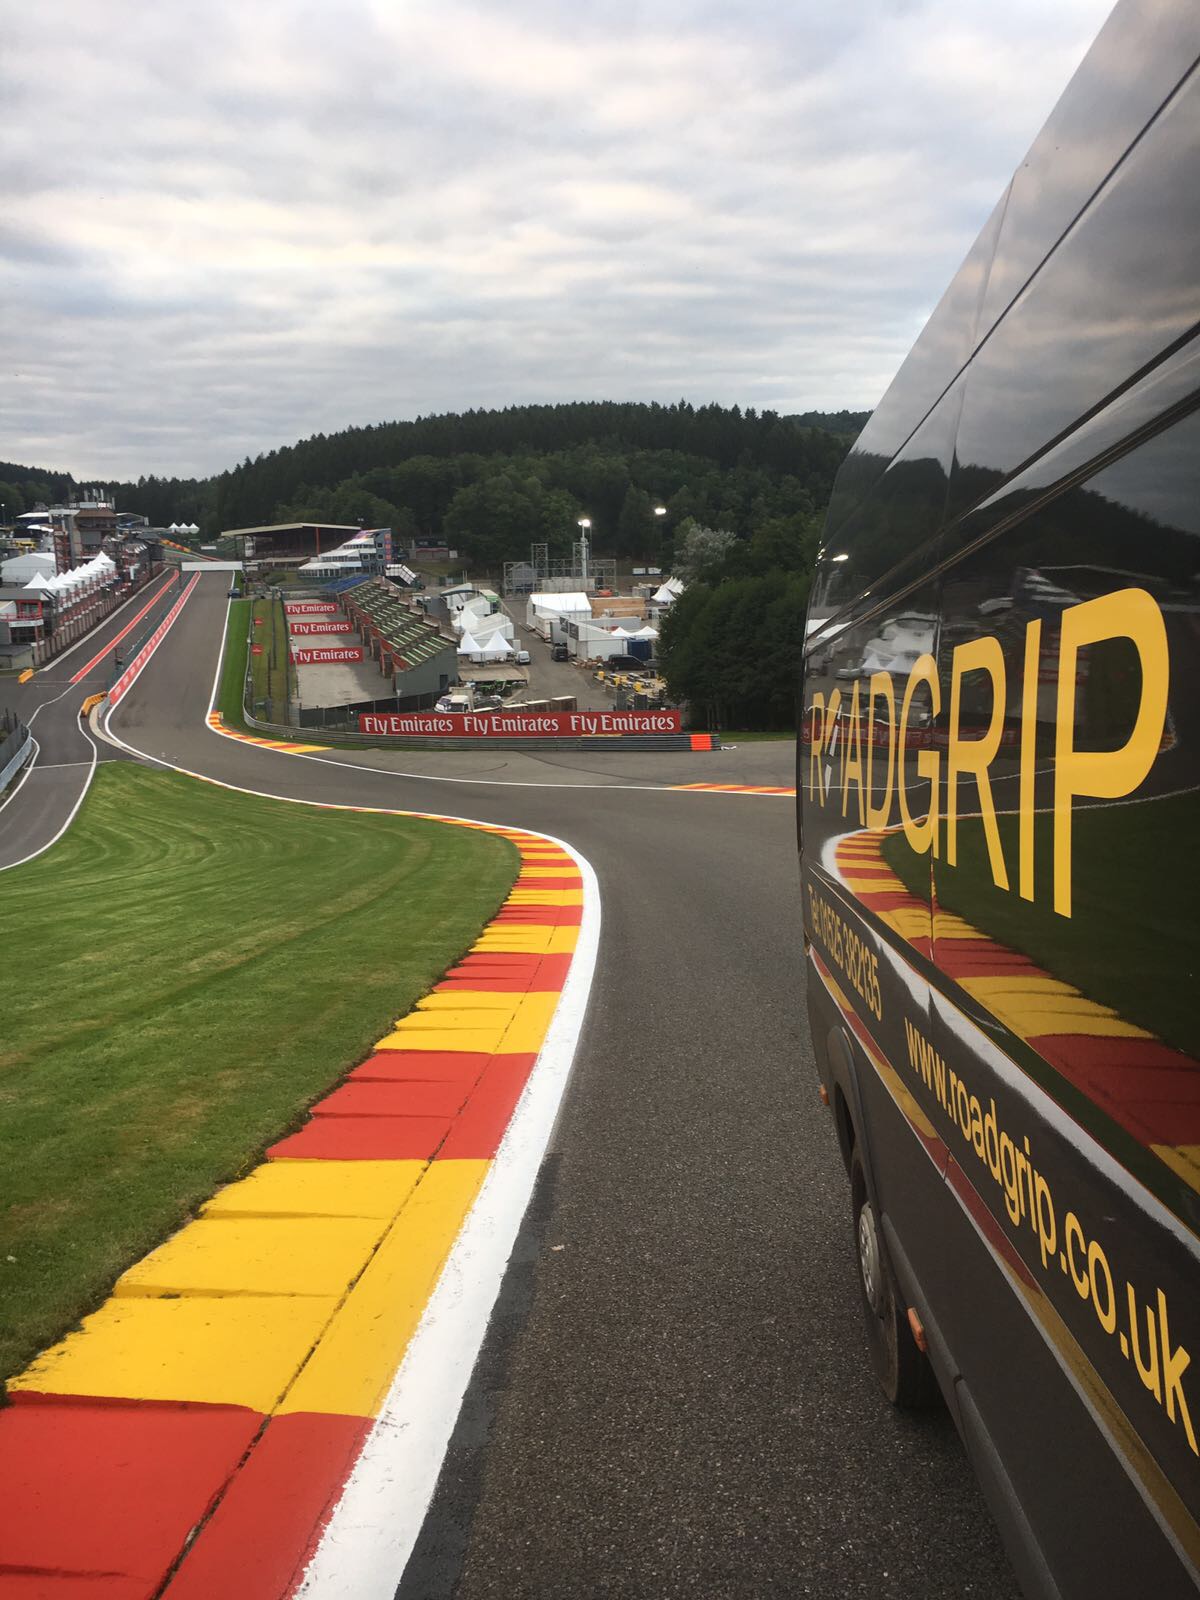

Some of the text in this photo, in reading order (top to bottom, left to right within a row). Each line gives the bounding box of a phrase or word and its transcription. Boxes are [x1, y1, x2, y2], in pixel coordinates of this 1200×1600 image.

[287, 604, 335, 613] Fly Emirates
[294, 623, 350, 633] Fly Emirates
[312, 649, 360, 661] Emirates
[364, 716, 454, 735] Fly Emirates
[463, 715, 559, 735] Fly Emirates
[570, 713, 675, 734] Fly Emirates
[842, 922, 882, 1022] 382135
[904, 1016, 1200, 1457] www.roadgrip.co.uk
